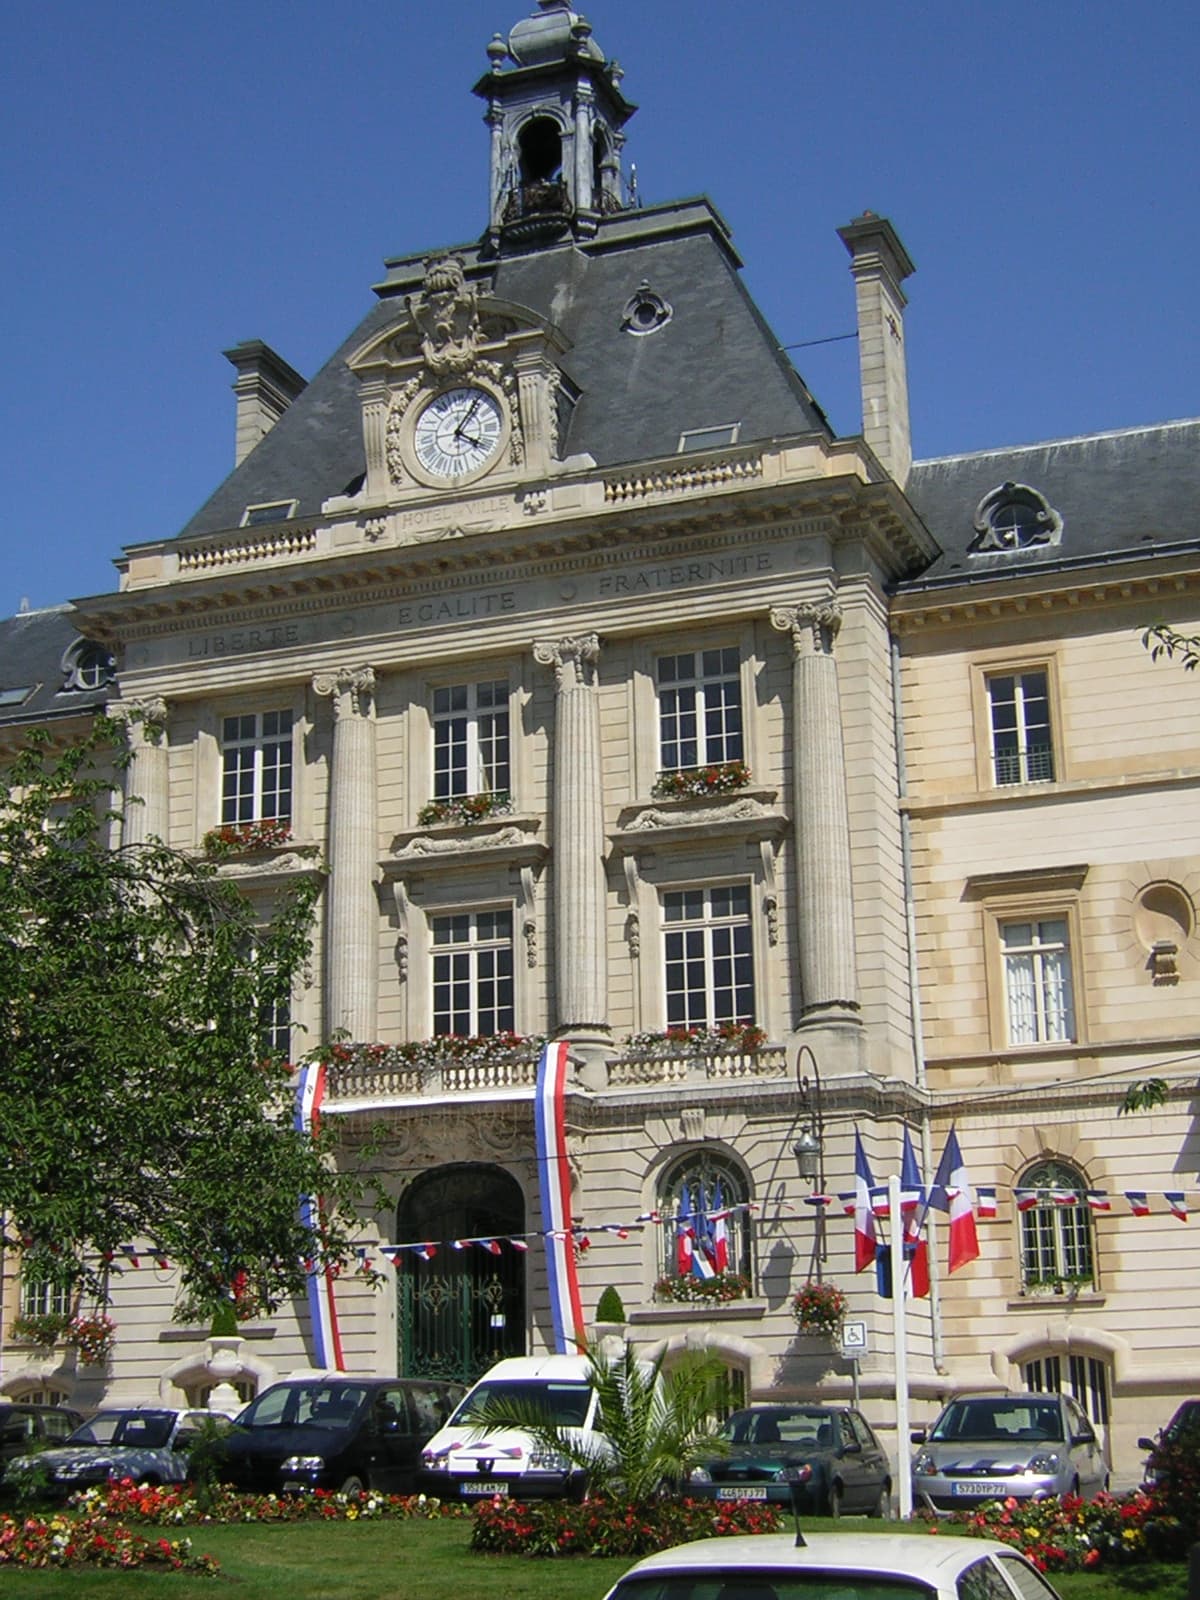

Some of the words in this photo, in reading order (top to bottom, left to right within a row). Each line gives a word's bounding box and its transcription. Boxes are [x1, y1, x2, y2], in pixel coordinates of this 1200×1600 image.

[402, 507, 451, 529] HOTEL
[465, 497, 508, 514] VILLE
[188, 625, 299, 657] LIBERTE
[399, 591, 516, 625] EGALITE
[600, 552, 772, 594] FRATERNITE
